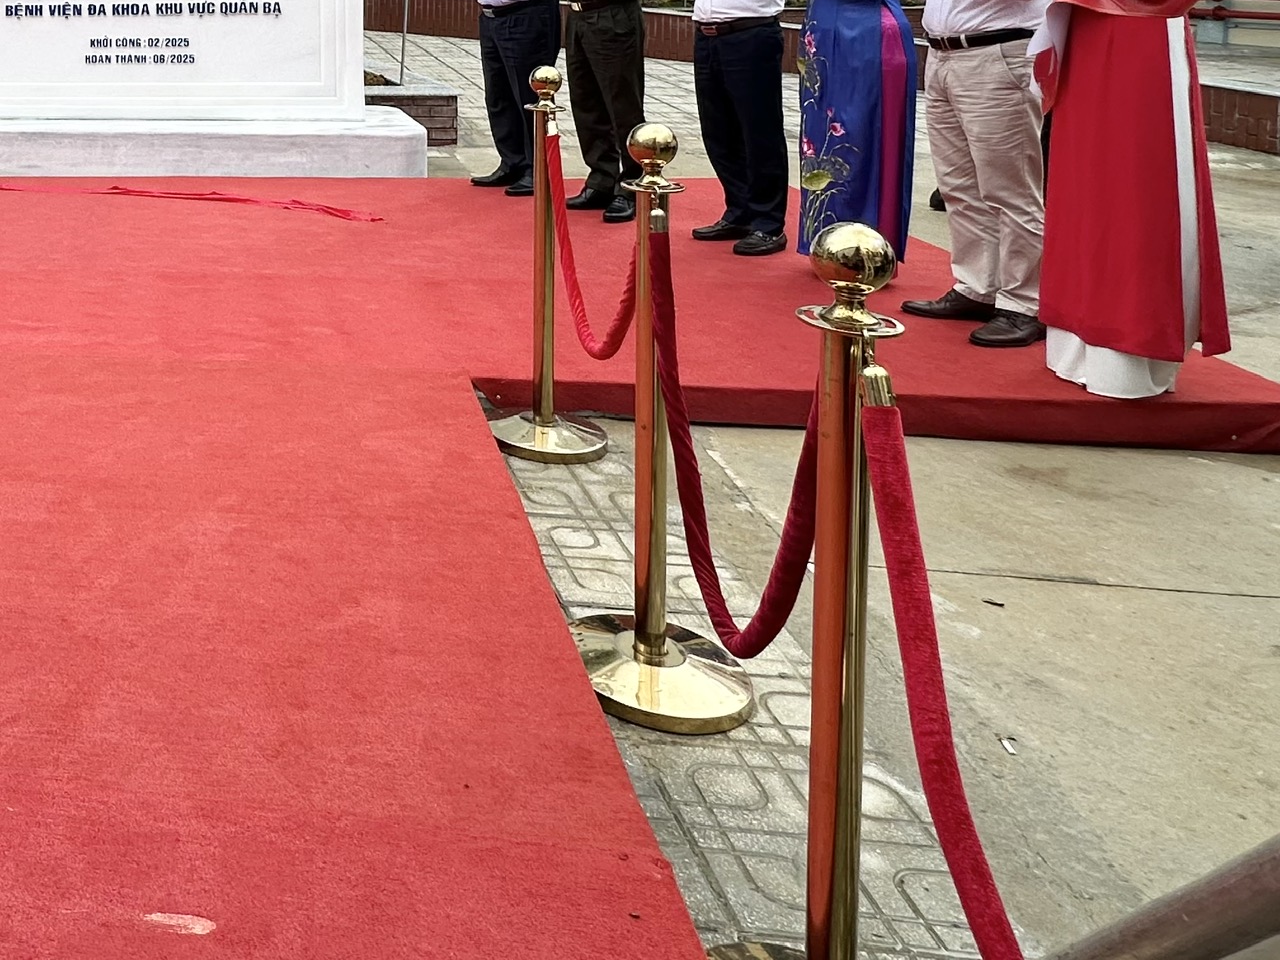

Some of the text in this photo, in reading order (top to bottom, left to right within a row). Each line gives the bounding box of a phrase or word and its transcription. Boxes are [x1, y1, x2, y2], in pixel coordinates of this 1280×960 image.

[5, 2, 43, 20] BỆNH
[48, 2, 82, 19] VIỆN
[87, 4, 107, 17] ĐA
[112, 3, 150, 16] KHOA
[156, 2, 183, 16] KHU
[187, 1, 215, 18] VỰC
[263, 1, 282, 18] BẠ
[90, 35, 112, 48] KHỞI
